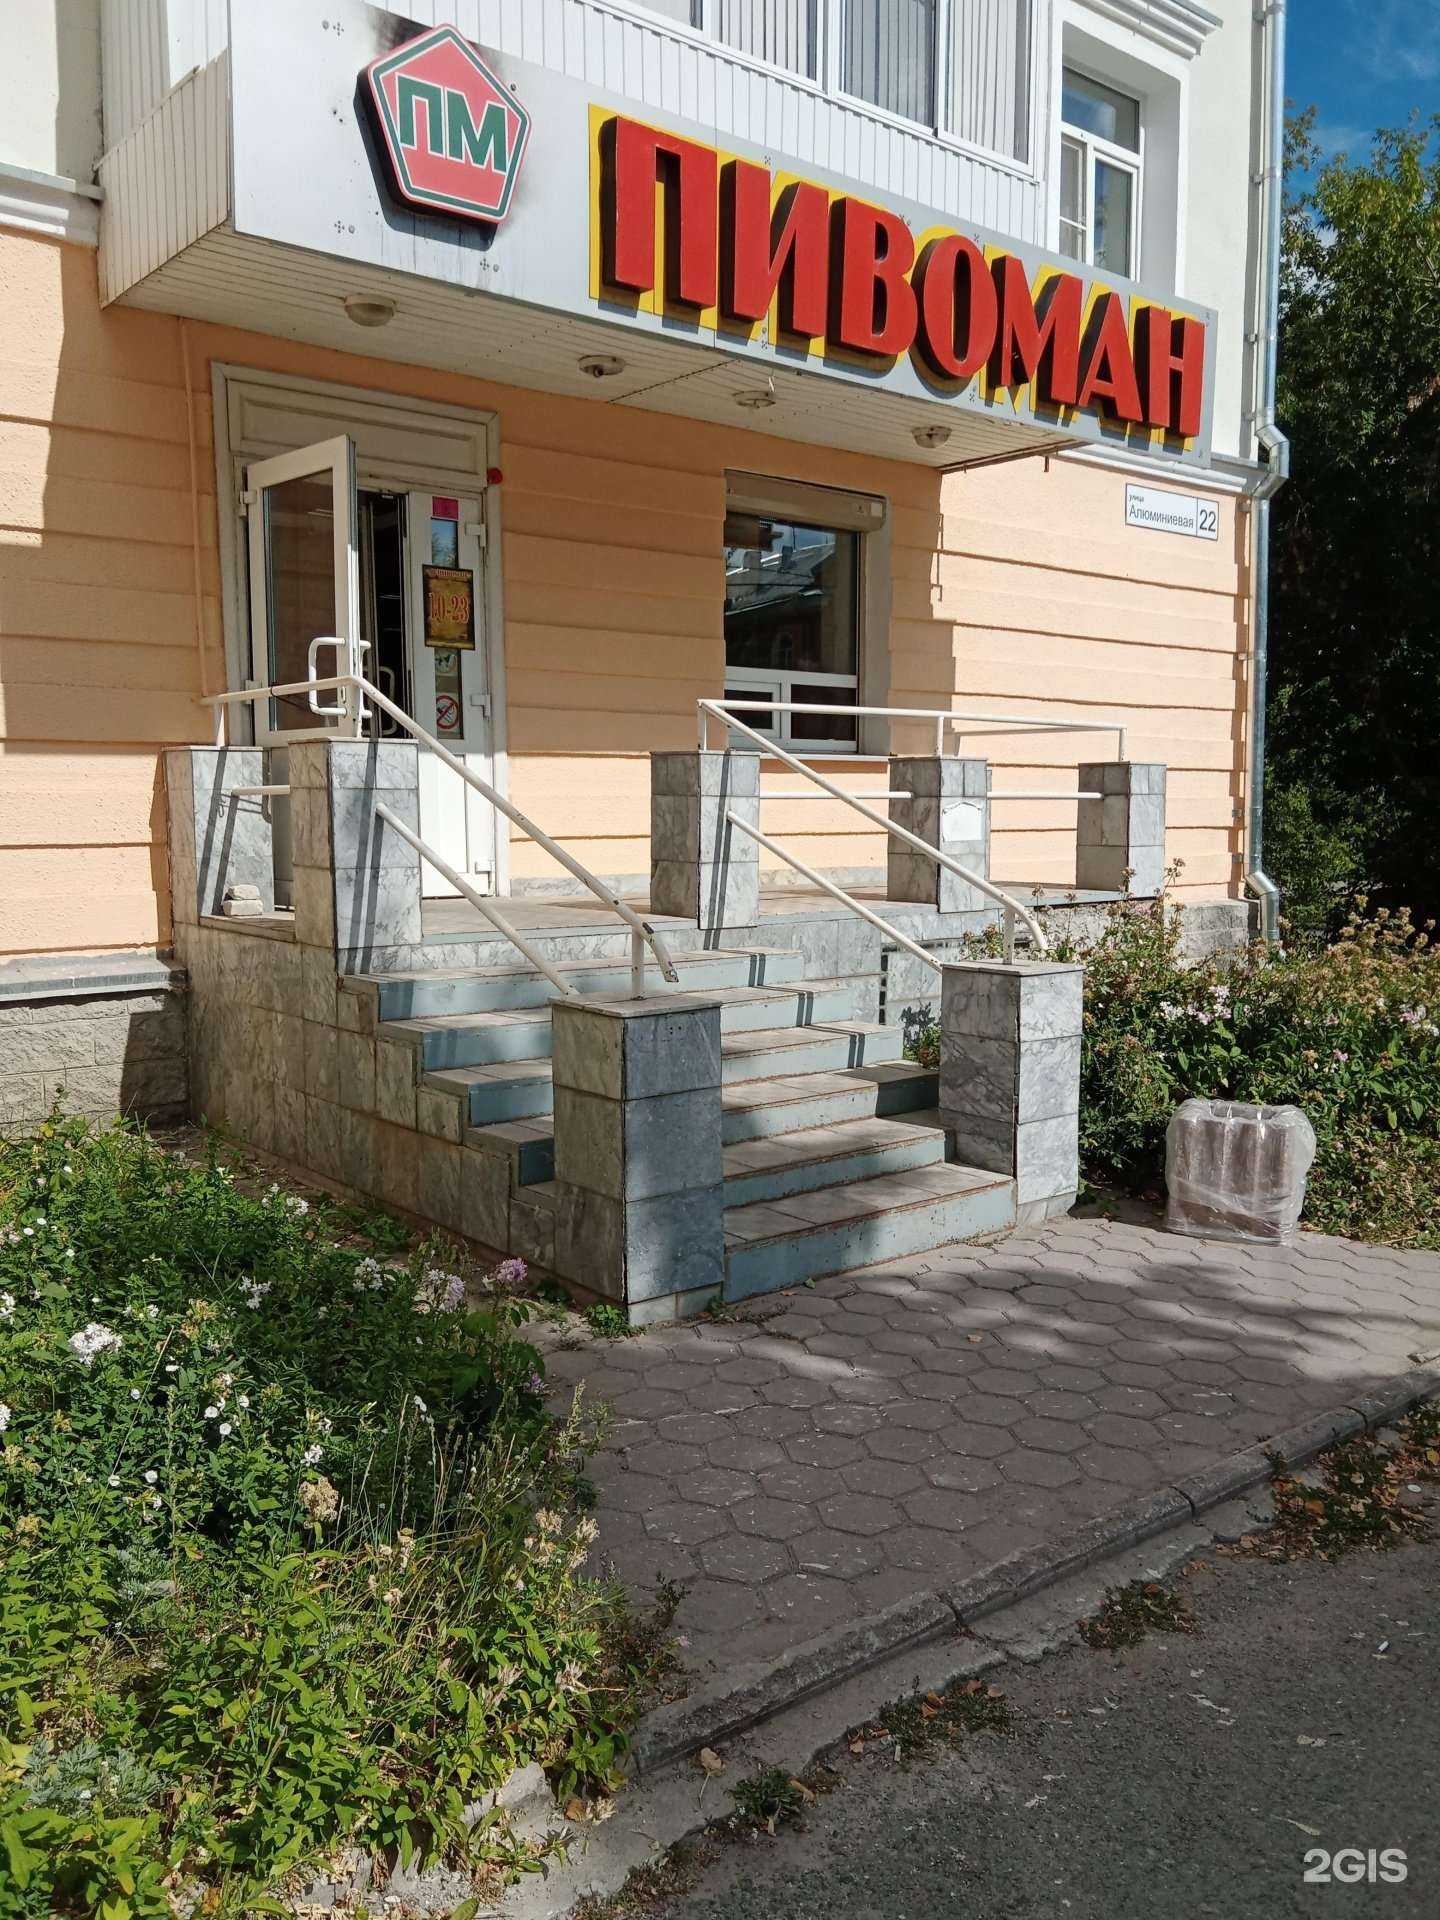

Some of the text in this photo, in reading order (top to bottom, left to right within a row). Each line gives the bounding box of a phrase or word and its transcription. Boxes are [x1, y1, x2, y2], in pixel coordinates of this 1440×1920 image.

[396, 72, 508, 176] ПМ
[601, 115, 1206, 438] ПИВОМАН
[1129, 494, 1144, 504] улица
[1129, 504, 1217, 533] Алюминиевая 22
